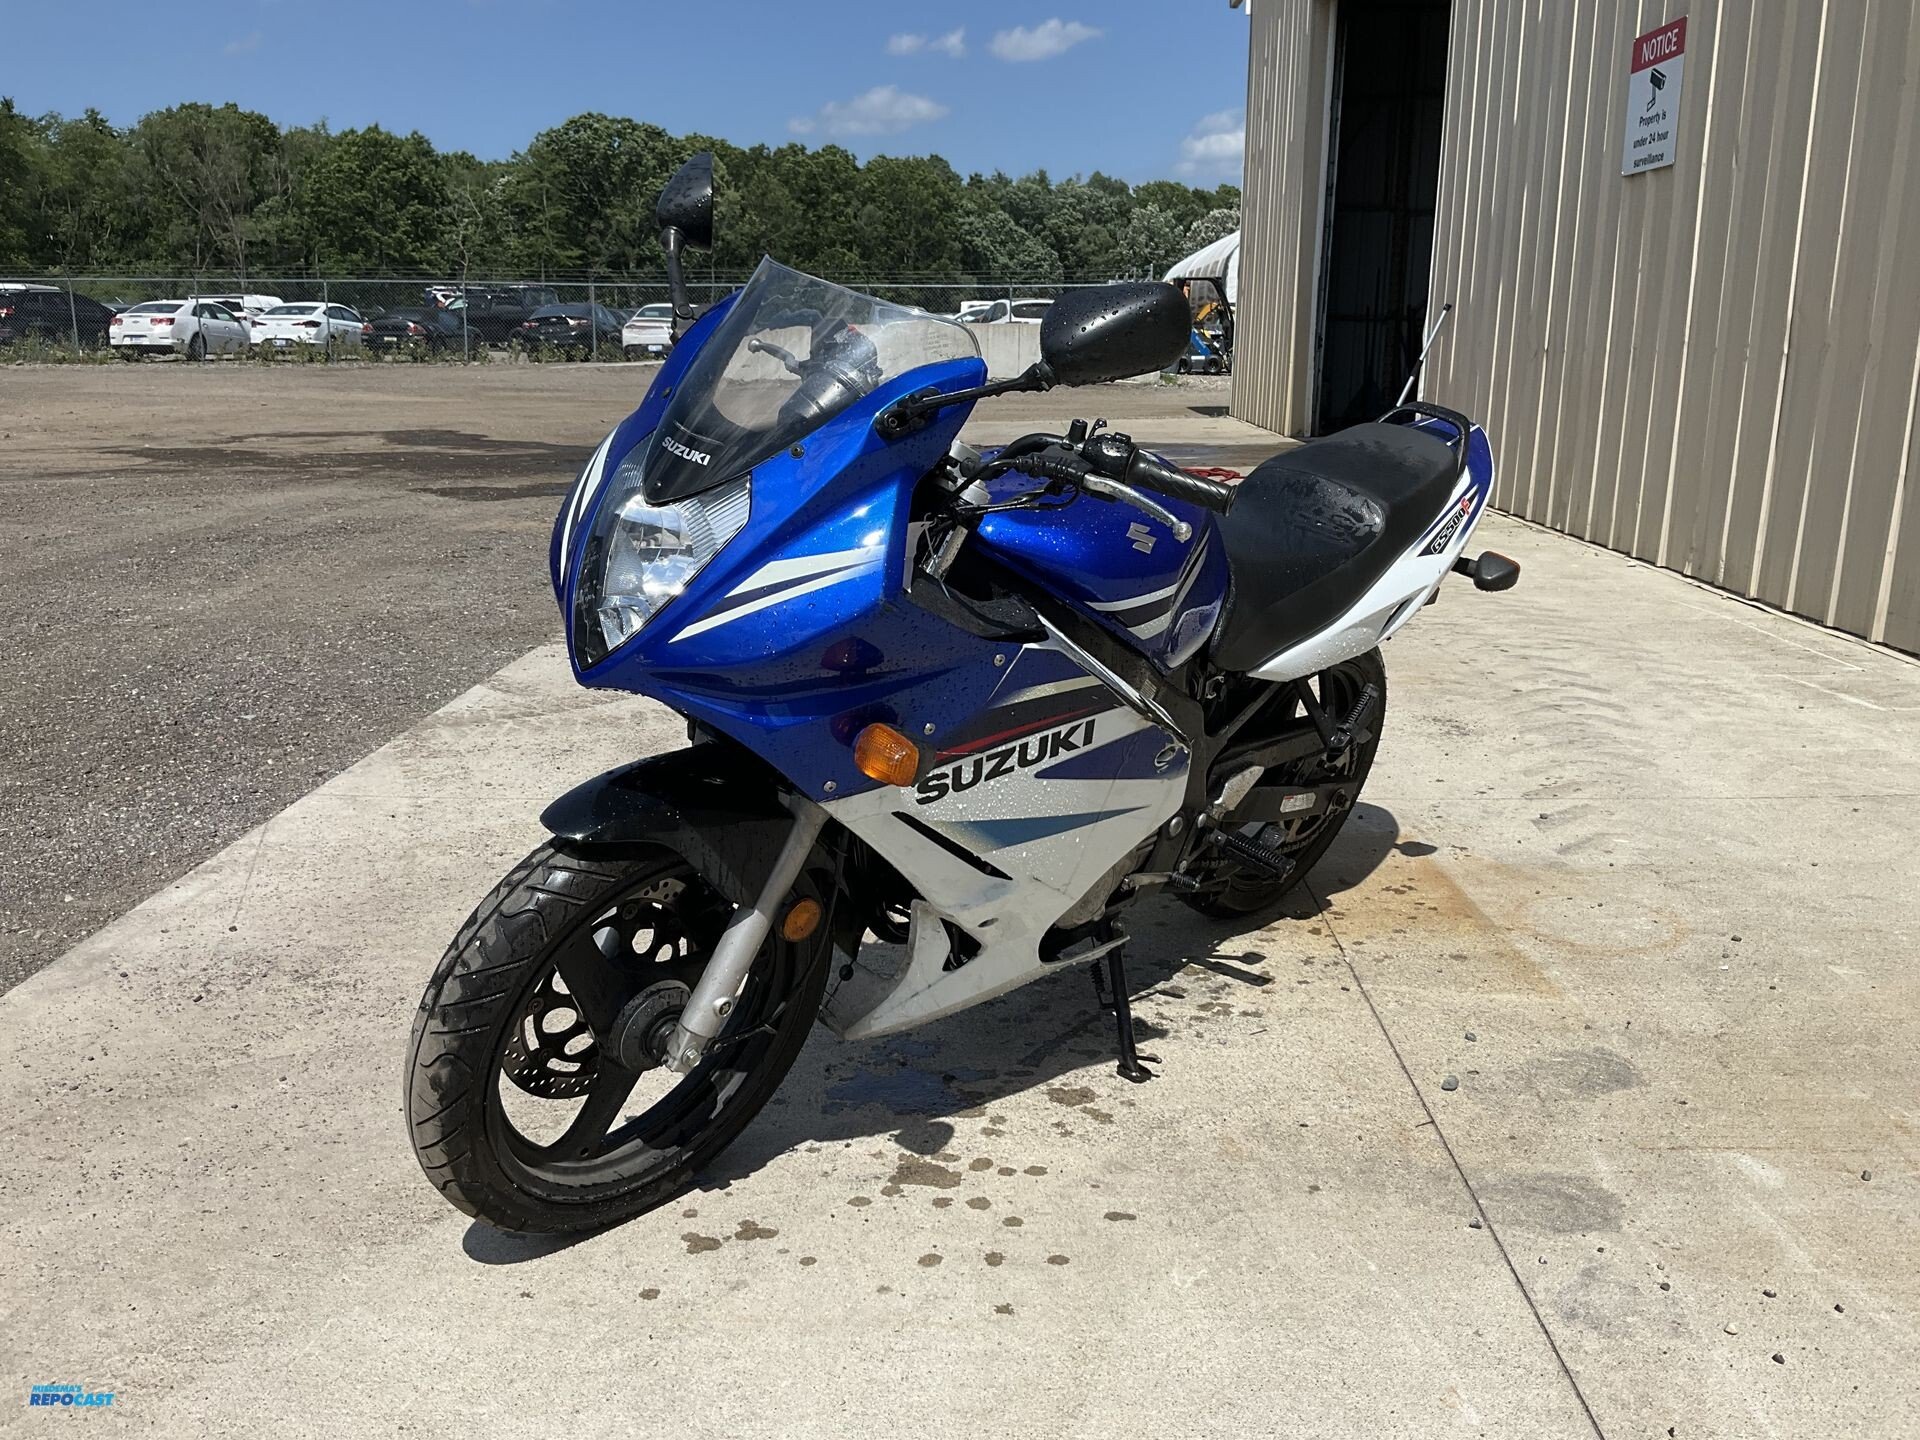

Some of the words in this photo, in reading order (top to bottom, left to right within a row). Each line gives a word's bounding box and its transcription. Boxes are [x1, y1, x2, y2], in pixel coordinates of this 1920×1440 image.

[1641, 29, 1678, 64] NOTICE
[1638, 112, 1660, 128] Property
[1661, 109, 1667, 120] is
[1633, 136, 1648, 149] under
[1648, 132, 1656, 144] 24
[1656, 130, 1669, 142] hour
[1633, 153, 1664, 168] surveillance
[662, 436, 711, 466] SUZUKI
[915, 718, 1096, 805] SUZUKI
